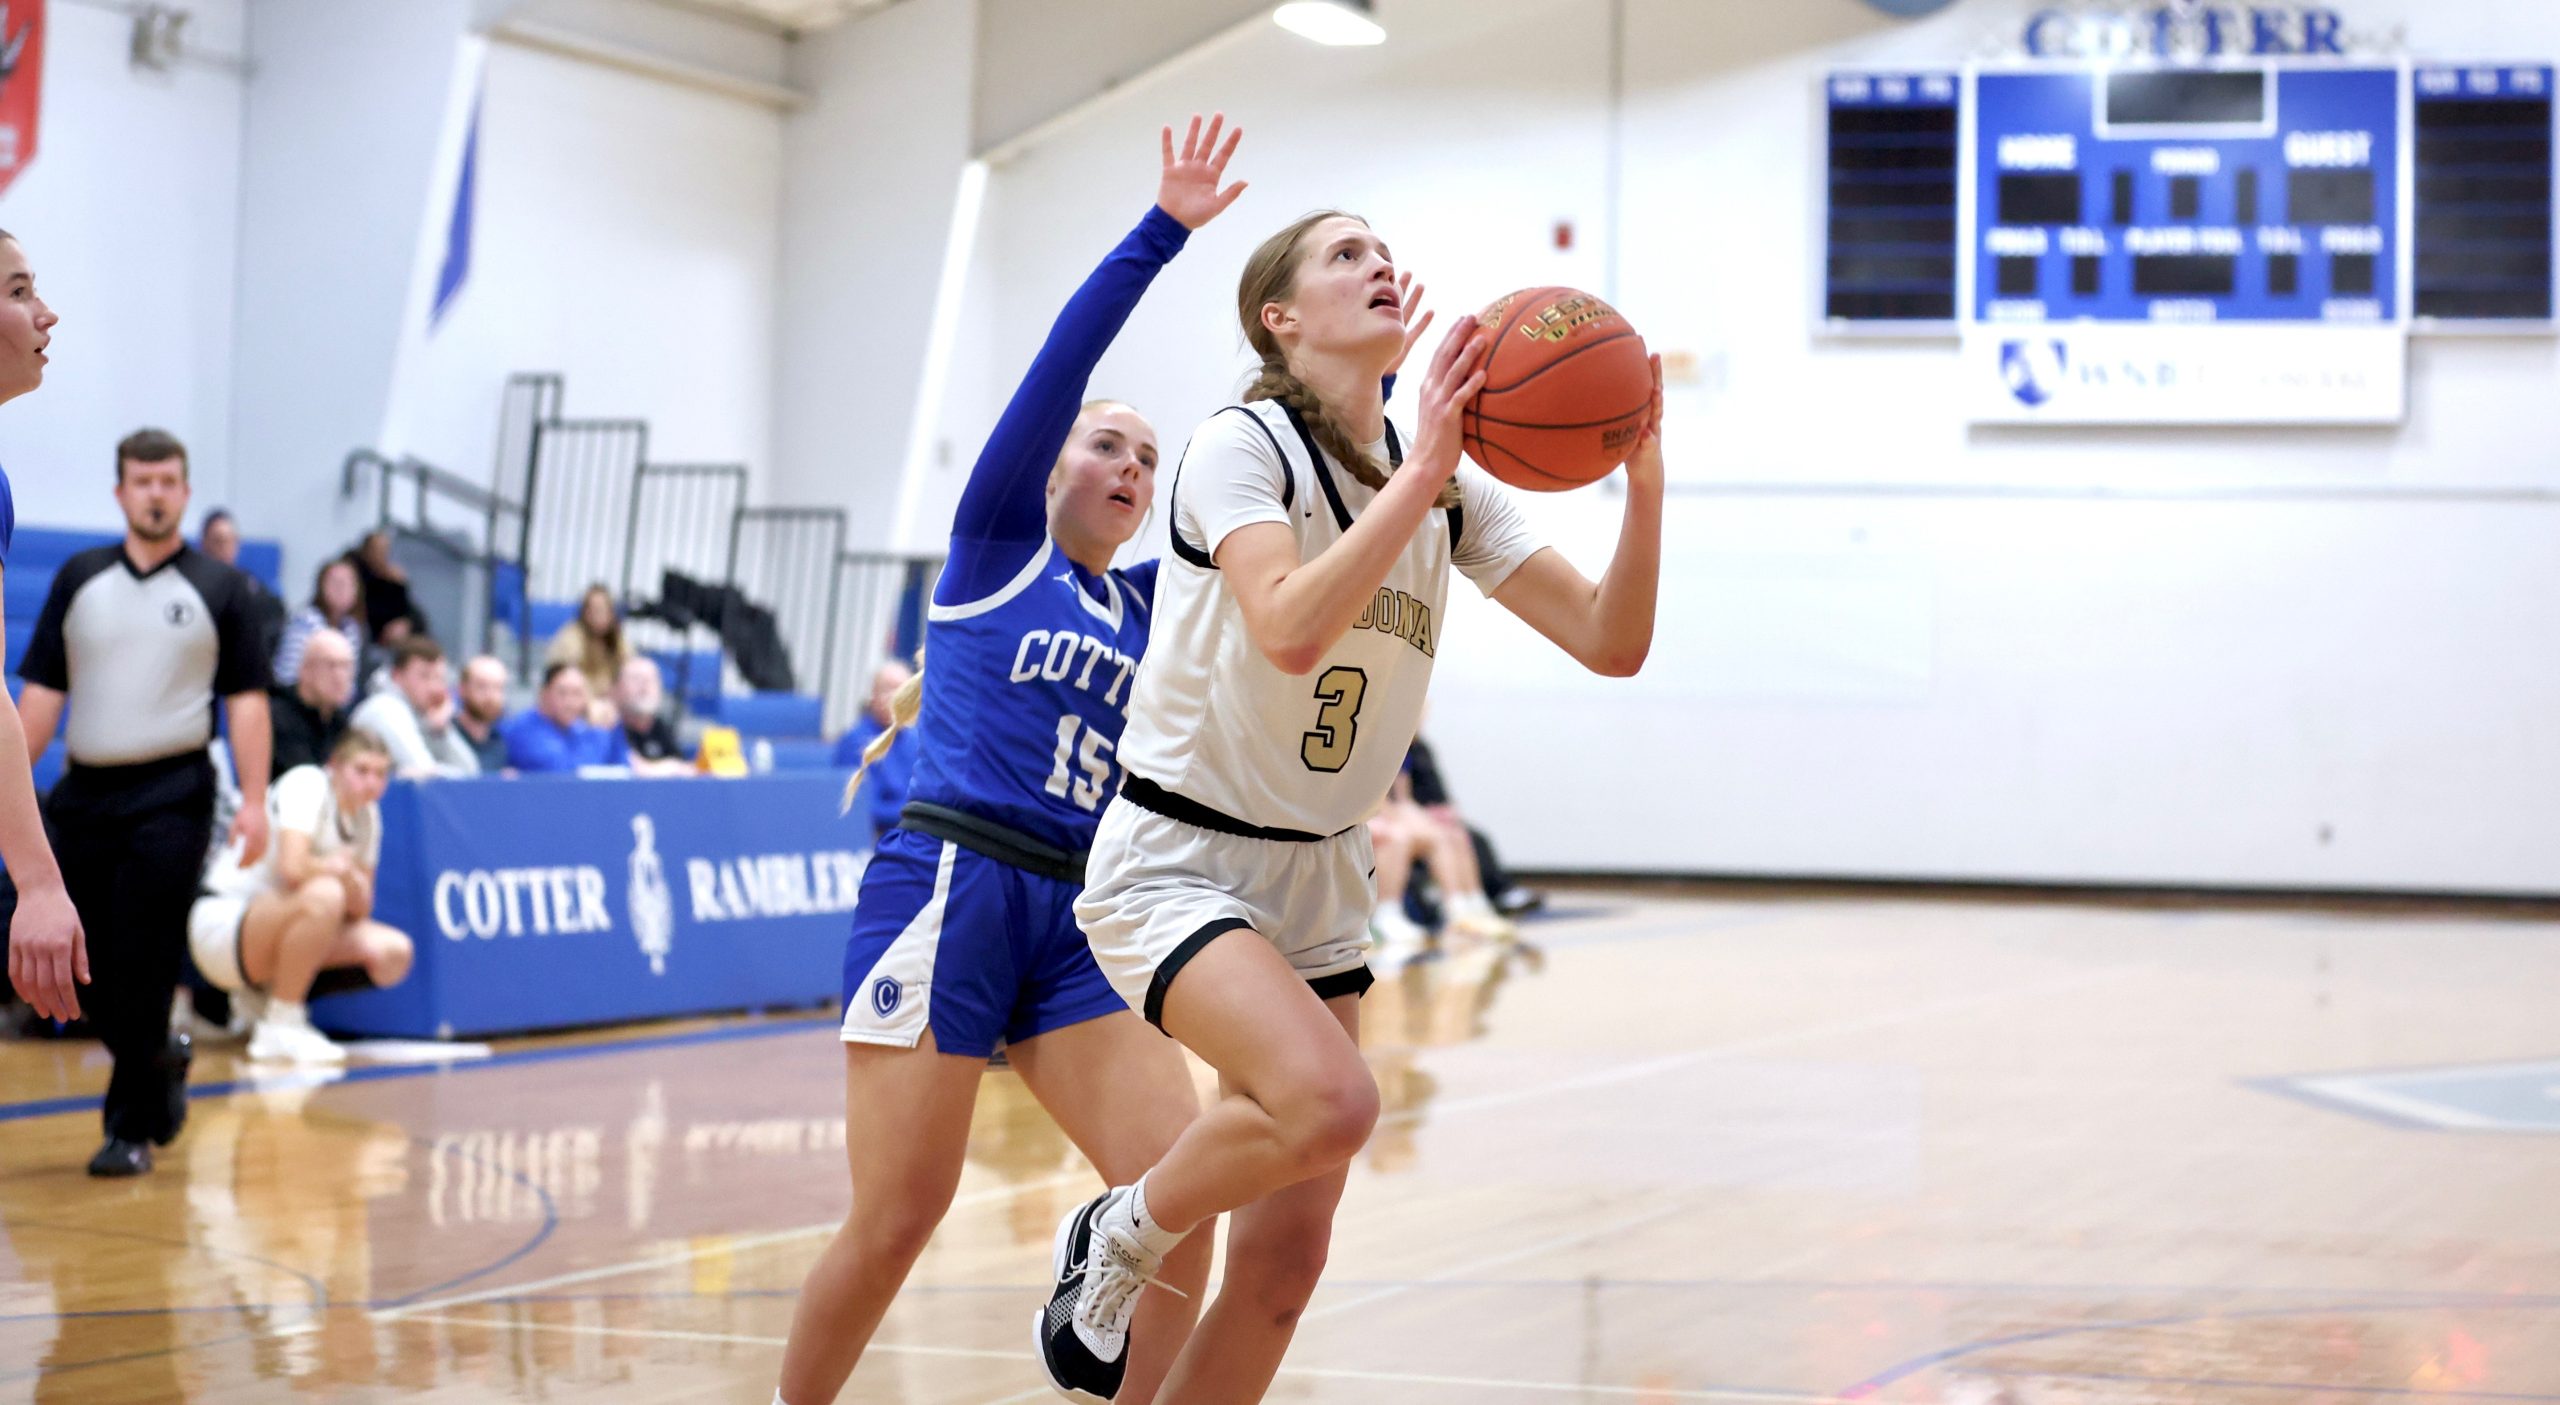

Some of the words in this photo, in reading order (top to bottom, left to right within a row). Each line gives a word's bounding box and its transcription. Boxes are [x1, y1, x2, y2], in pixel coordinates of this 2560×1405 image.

[1010, 629, 1138, 720] COTT
[1301, 665, 1368, 773] 3
[1045, 714, 1114, 812] 15
[433, 866, 613, 942] COTTER
[877, 982, 895, 1011] C
